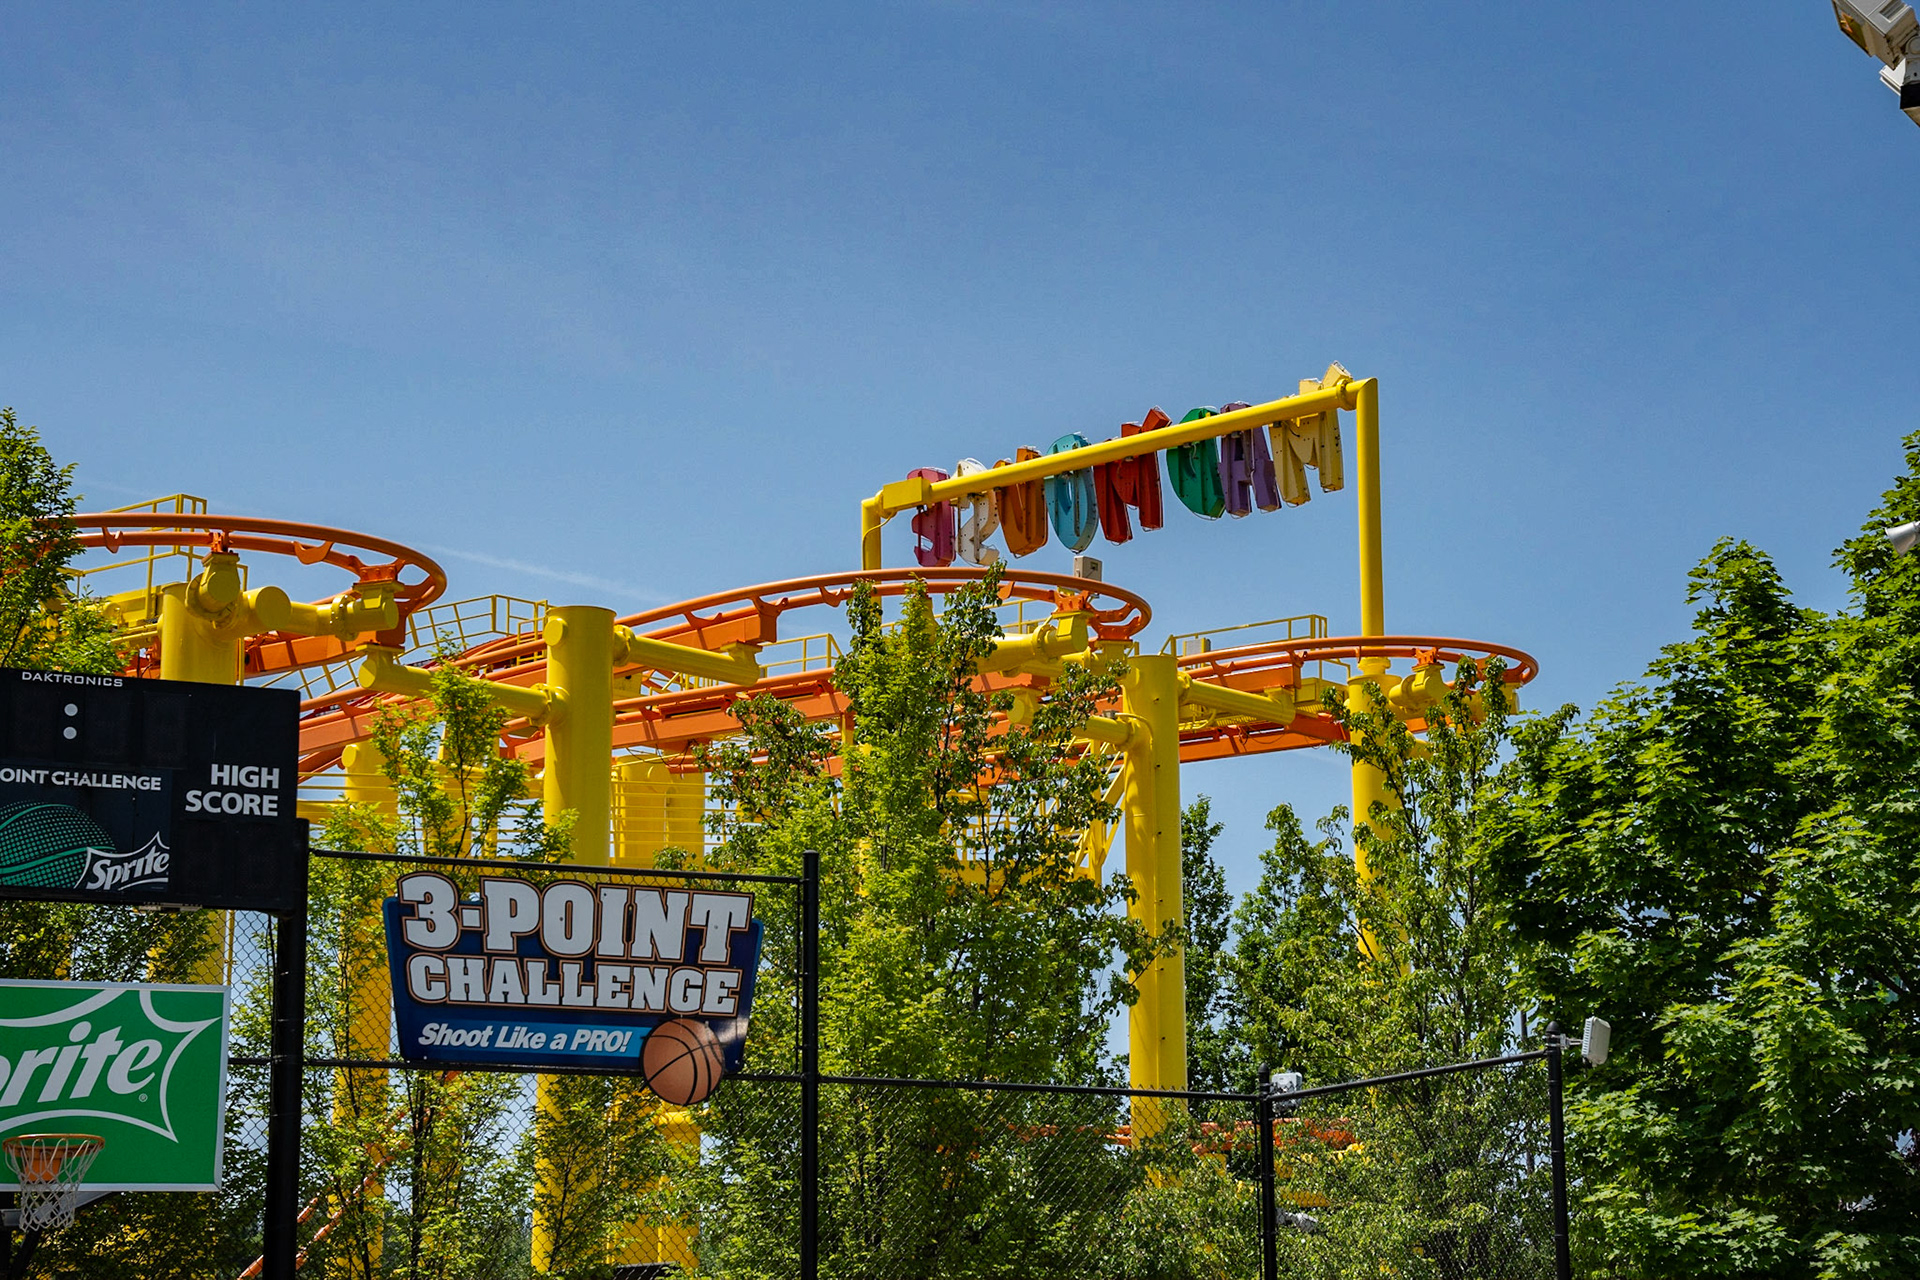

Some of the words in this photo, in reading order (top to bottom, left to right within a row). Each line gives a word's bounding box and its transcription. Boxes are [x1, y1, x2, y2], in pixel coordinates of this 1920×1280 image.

[21, 671, 124, 688] DAKTRONICS
[51, 771, 162, 791] CHALLENGE
[210, 763, 280, 789] HIGH
[185, 790, 279, 817] SCORE
[85, 845, 170, 891] Sprite
[398, 871, 755, 966] 3-POINT
[406, 952, 743, 1017] CHALLENGE
[418, 1022, 494, 1048] Shoot
[495, 1025, 547, 1050] Like
[550, 1033, 566, 1051] a
[570, 1029, 633, 1054] PRO!
[0, 1020, 163, 1108] rite
